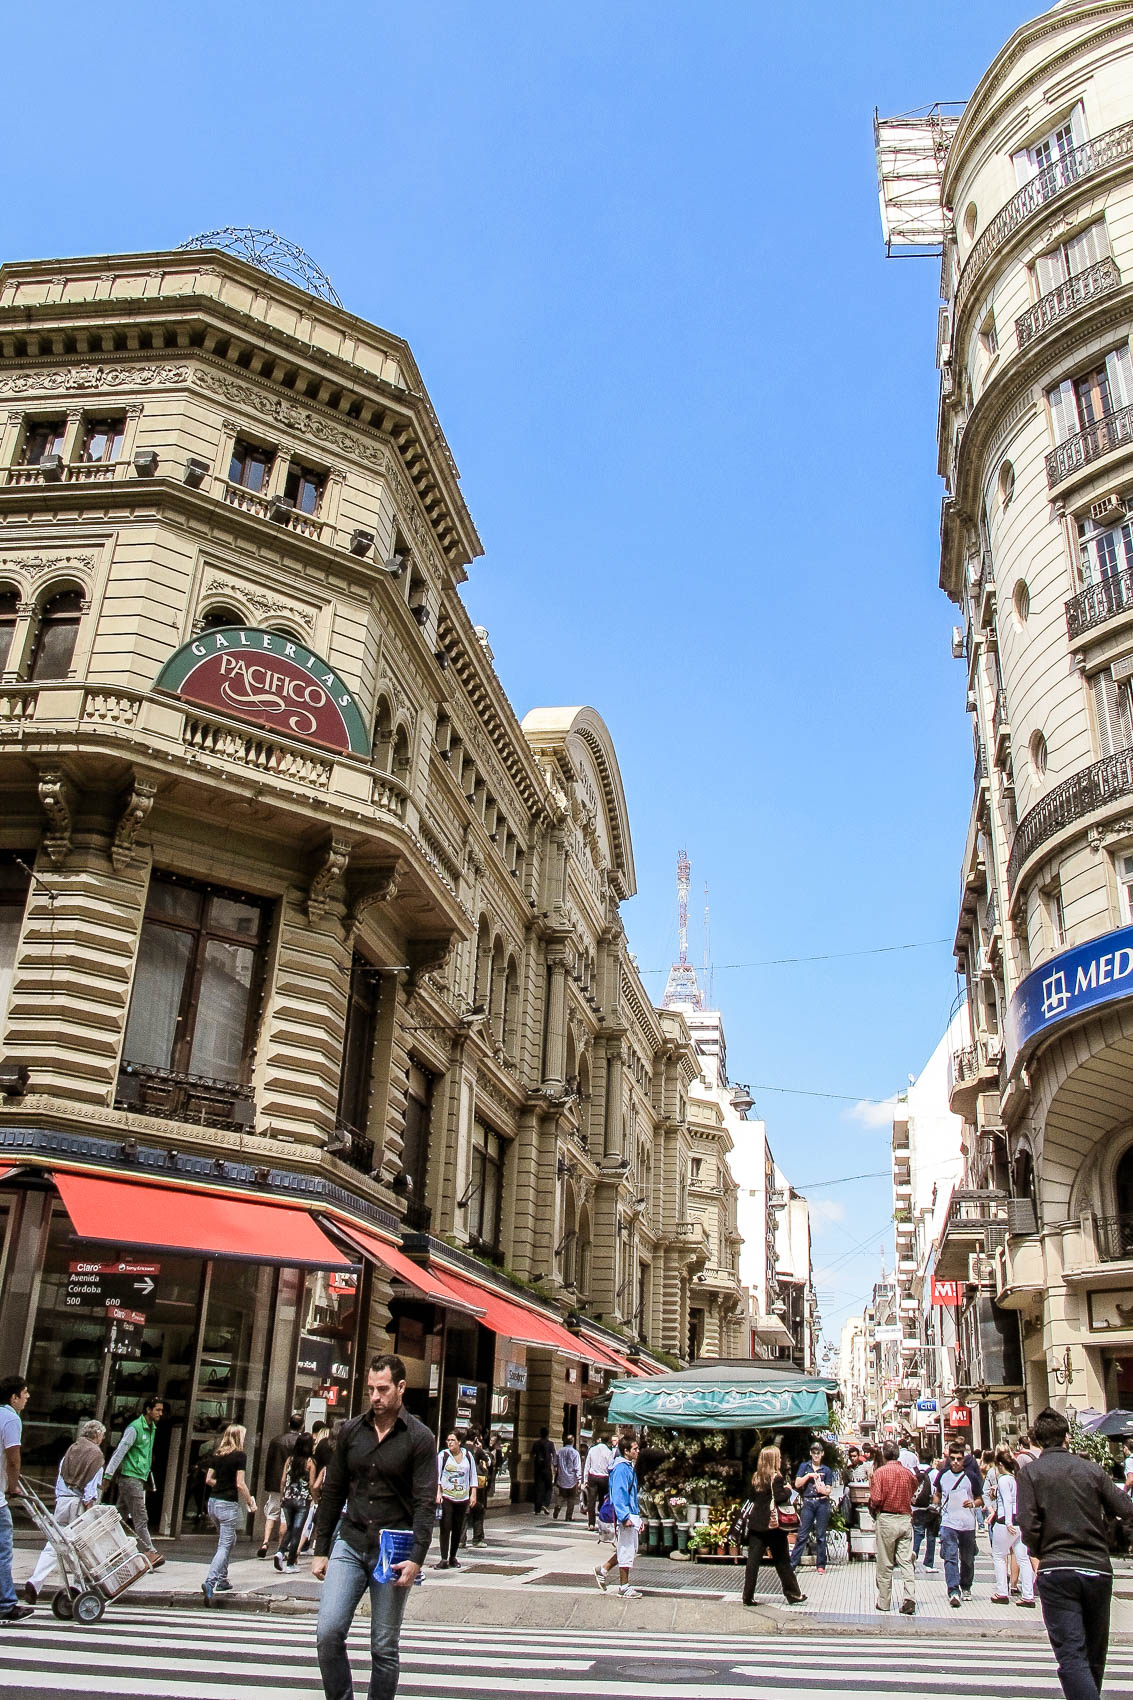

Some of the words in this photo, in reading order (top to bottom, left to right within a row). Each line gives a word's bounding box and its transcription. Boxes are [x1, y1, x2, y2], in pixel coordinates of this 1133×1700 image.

[191, 631, 352, 708] GALERIAS
[218, 653, 327, 709] PACIFICO
[1074, 947, 1133, 996] MED
[77, 1264, 100, 1272] Claro
[935, 1283, 956, 1296] M!
[920, 1402, 934, 1410] citi
[952, 1410, 967, 1421] M!
